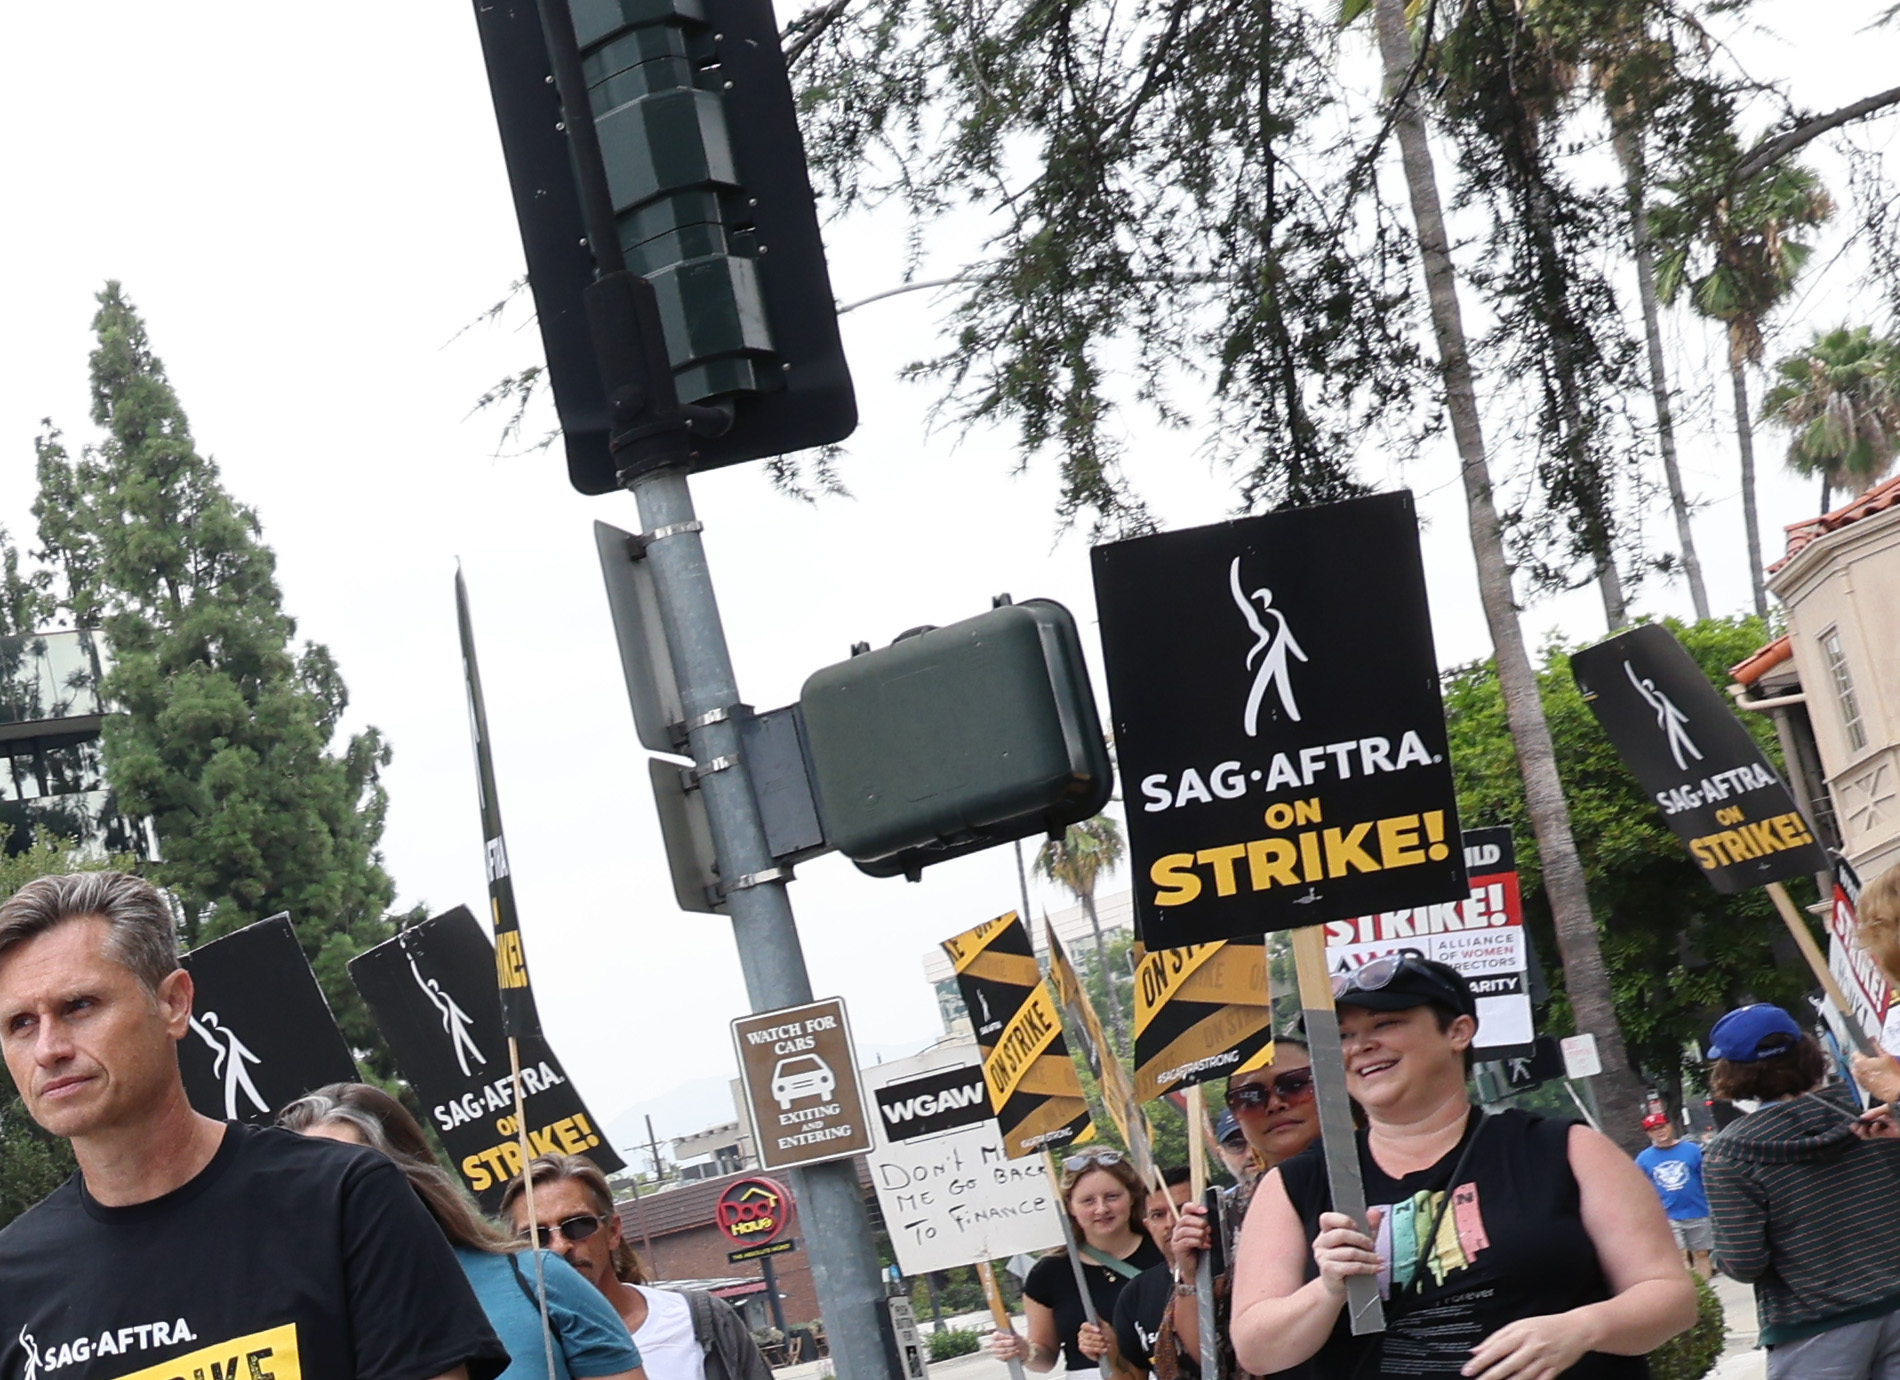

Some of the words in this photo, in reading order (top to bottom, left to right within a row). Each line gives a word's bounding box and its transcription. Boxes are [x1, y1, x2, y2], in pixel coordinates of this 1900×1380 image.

[1264, 797, 1323, 830] ON
[1715, 805, 1746, 826] ON
[1689, 811, 1814, 870] STRIKE!
[1150, 809, 1450, 906] STRIKE!
[1439, 934, 1514, 950] ALLIANCE
[1439, 951, 1457, 961] OF
[1461, 946, 1514, 958] WOMEN
[746, 1022, 802, 1046] WATCH
[805, 1015, 838, 1033] FOR
[774, 1035, 816, 1055] CARS
[990, 1053, 1012, 1094] ON
[1003, 1000, 1053, 1073] STRIKE
[778, 1103, 841, 1126] EXITING
[881, 1081, 984, 1124] WGAW
[777, 1125, 852, 1150] ENTERING
[801, 1120, 824, 1132] AND
[896, 1192, 935, 1213] ME
